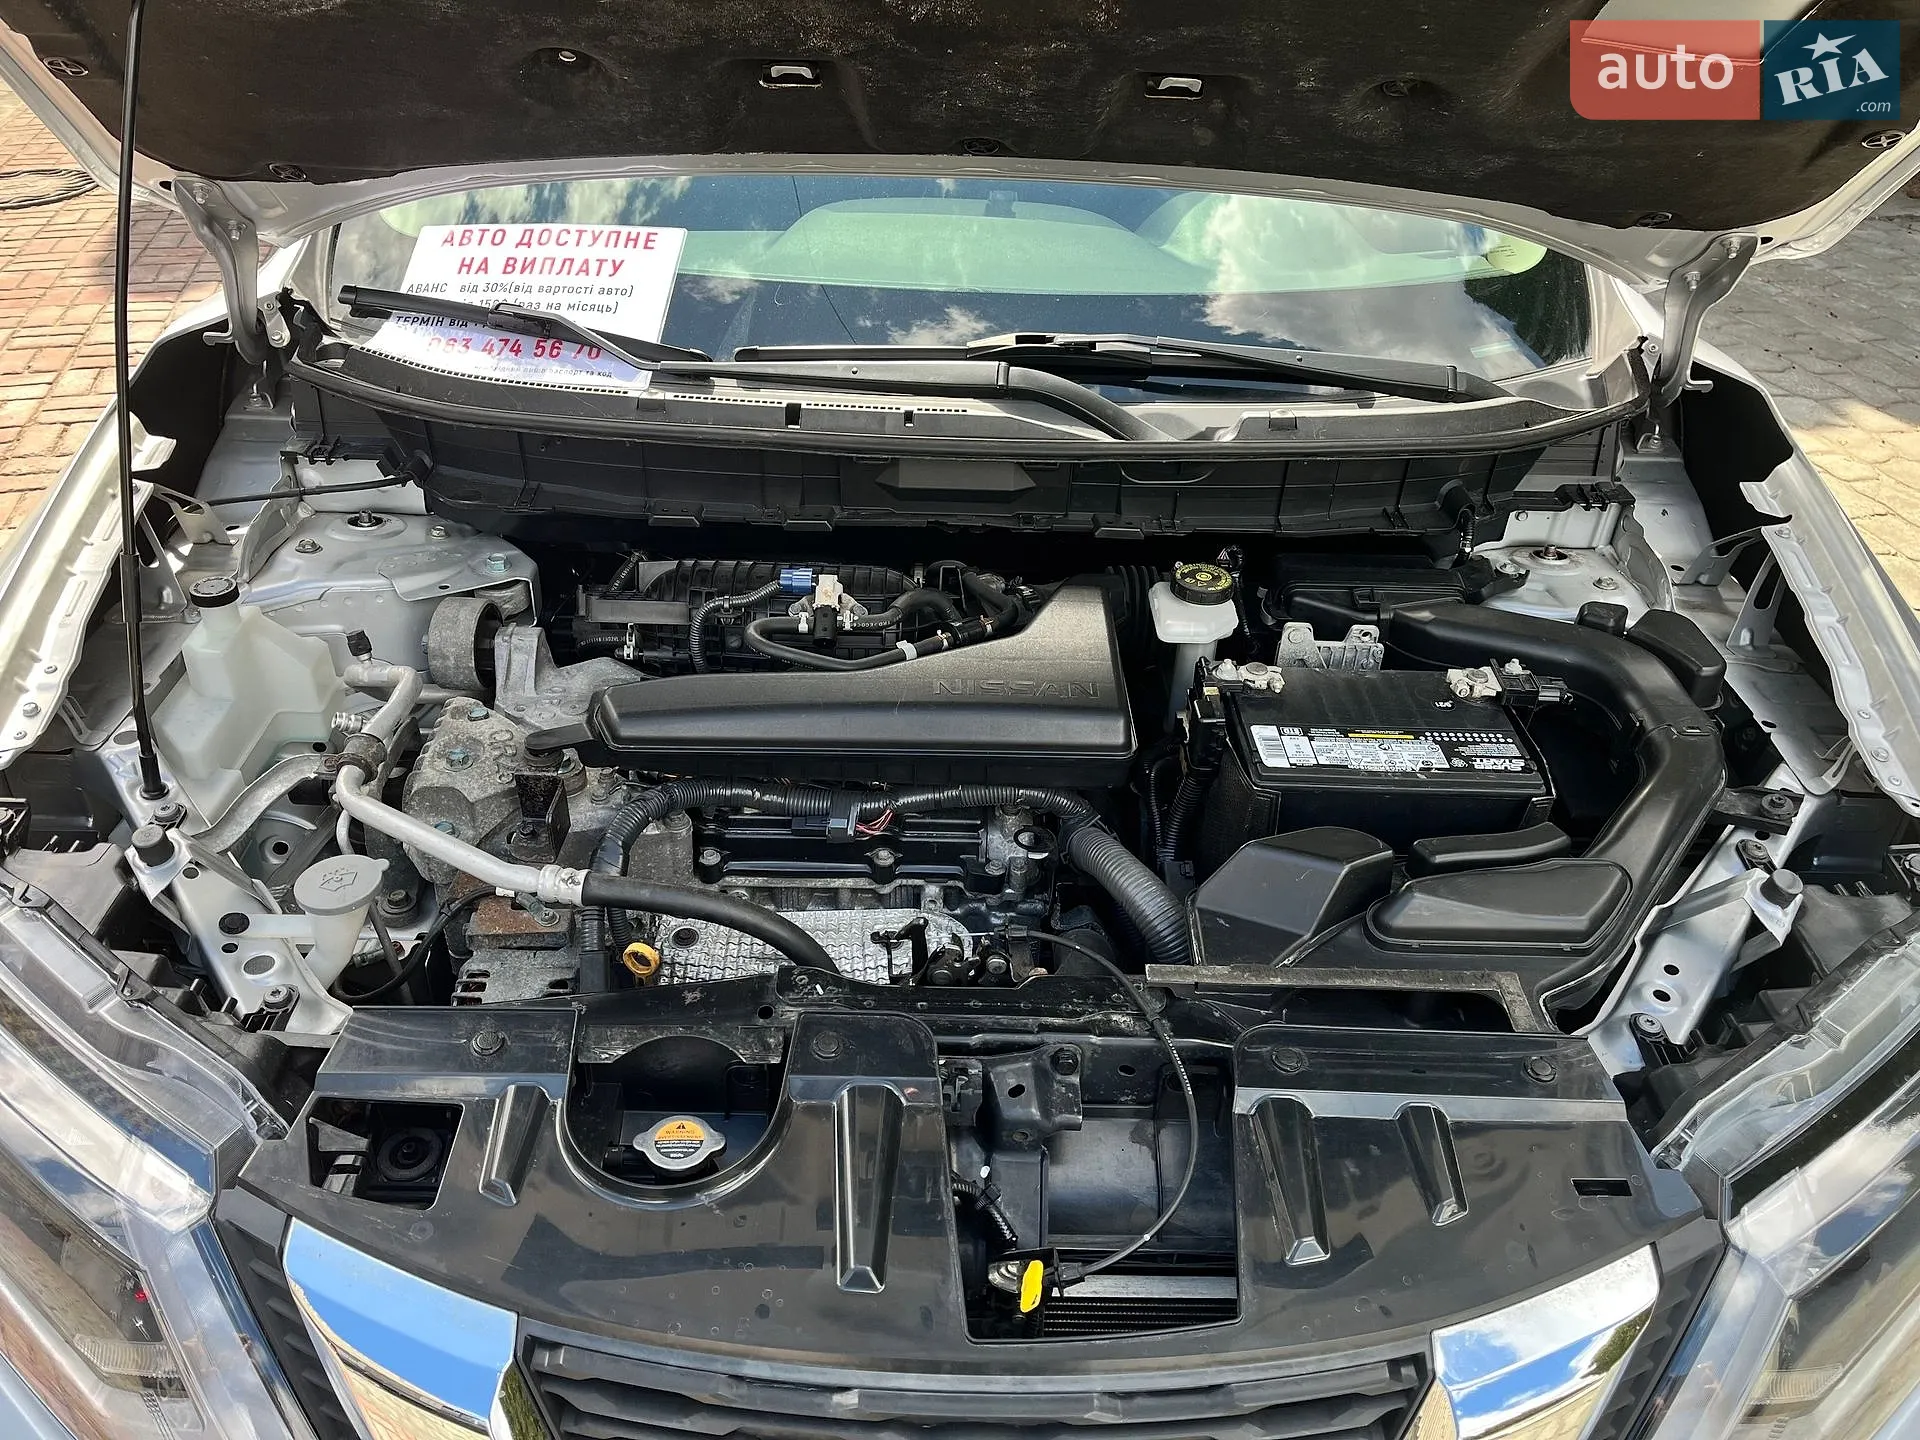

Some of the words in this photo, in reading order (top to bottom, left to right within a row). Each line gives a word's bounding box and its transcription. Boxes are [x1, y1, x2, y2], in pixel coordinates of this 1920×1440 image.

[440, 228, 507, 247] АВТО
[515, 228, 659, 250] ДОСТУПНЕ
[457, 256, 490, 275] НА
[502, 256, 625, 277] ВИПЛАТУ
[406, 282, 448, 294] АВАНС
[459, 282, 479, 294] від
[537, 284, 594, 296] вартості
[546, 301, 562, 311] на
[481, 336, 522, 357] 474
[533, 337, 564, 359] 56
[933, 678, 1100, 699] NISSAN
